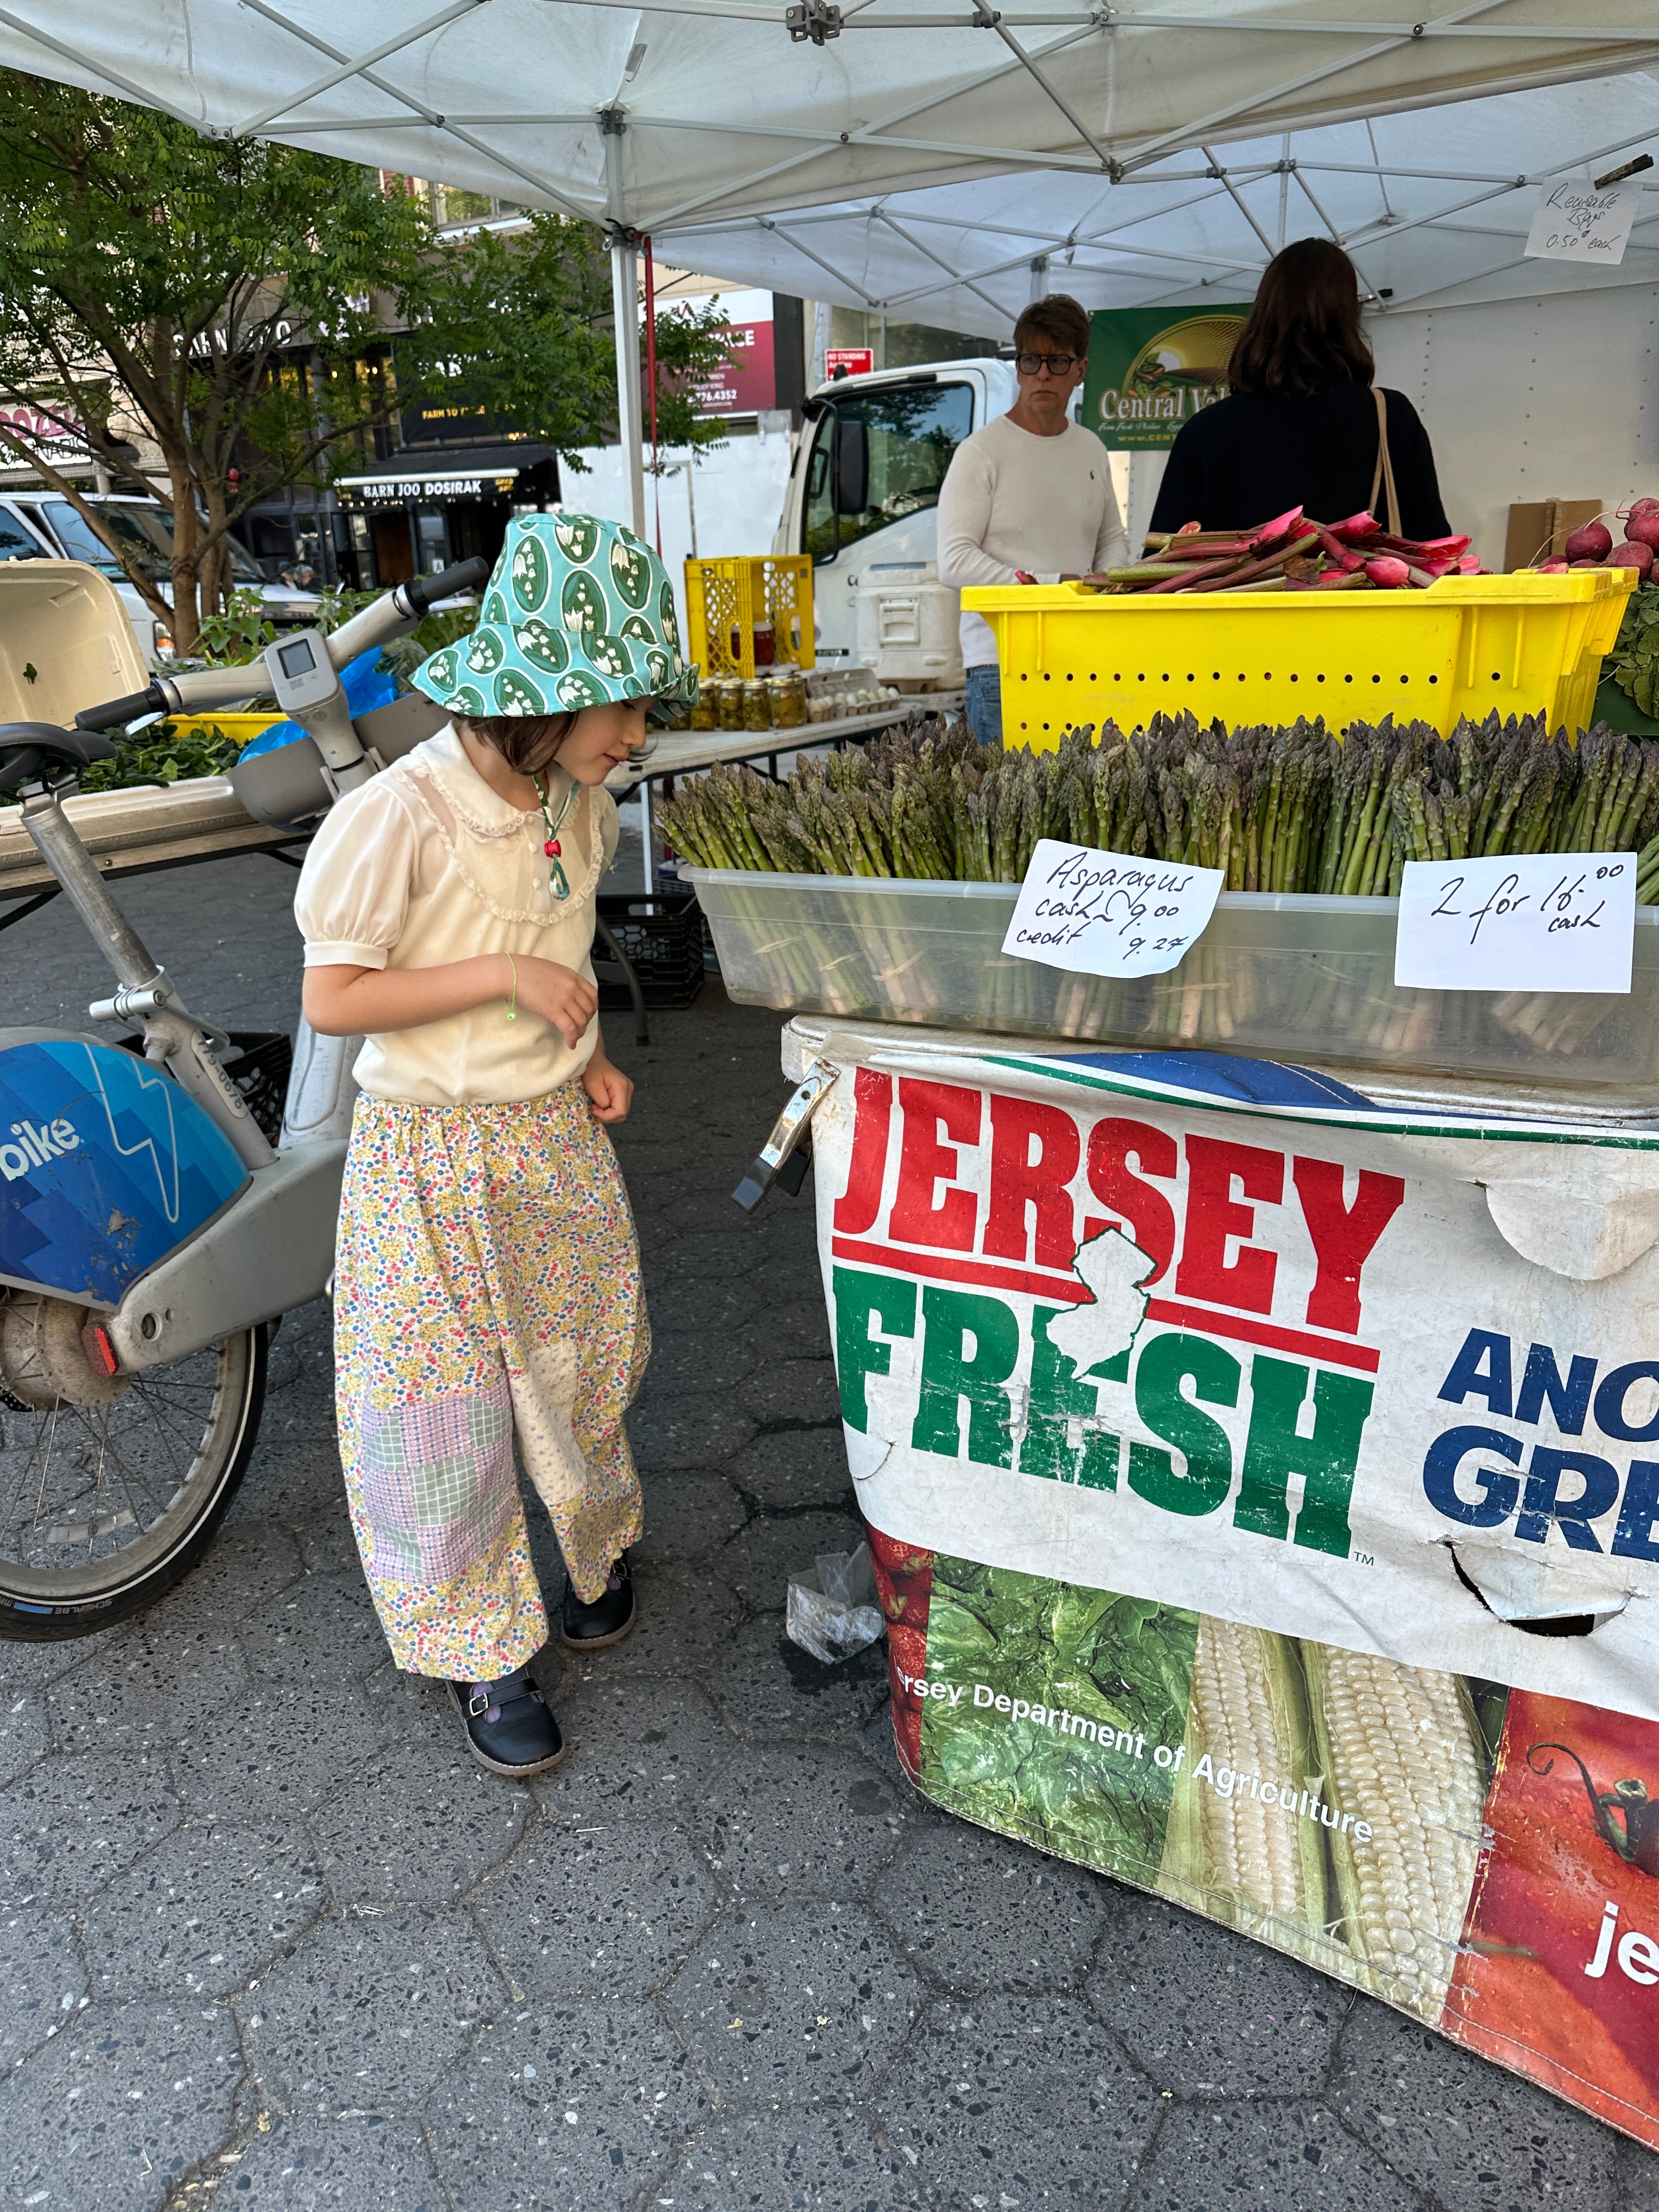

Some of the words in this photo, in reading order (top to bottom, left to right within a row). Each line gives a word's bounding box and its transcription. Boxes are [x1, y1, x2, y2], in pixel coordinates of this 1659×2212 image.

[1547, 183, 1621, 210] Reusable
[1567, 208, 1606, 230] Bags
[1588, 234, 1622, 250] each
[837, 352, 866, 360] STANDING
[422, 408, 445, 420] FARM
[1100, 386, 1185, 420] Central
[1189, 383, 1231, 415] Val
[363, 484, 394, 498] BARN
[398, 482, 420, 497] JOO
[424, 479, 482, 495] DOSIRAK
[1047, 851, 1194, 905] Asparagus
[1035, 890, 1104, 920] cash
[1431, 877, 1465, 917] 2
[1469, 873, 1530, 945] for
[1548, 900, 1605, 933] cash
[1016, 921, 1092, 945] credit
[1122, 935, 1188, 960] 9.27
[197, 1041, 244, 1109] 119-0678
[0, 1116, 80, 1181] bike
[833, 1066, 1406, 1335] JERSEY
[1437, 1327, 1659, 1442] ANO
[832, 1265, 1375, 1560] FRESH
[54, 1598, 113, 1615] SCHWALBE
[973, 1684, 1147, 1760] Department
[1153, 1742, 1188, 1772] of
[1192, 1752, 1375, 1844] Agriculture
[1584, 1900, 1659, 1986] je
